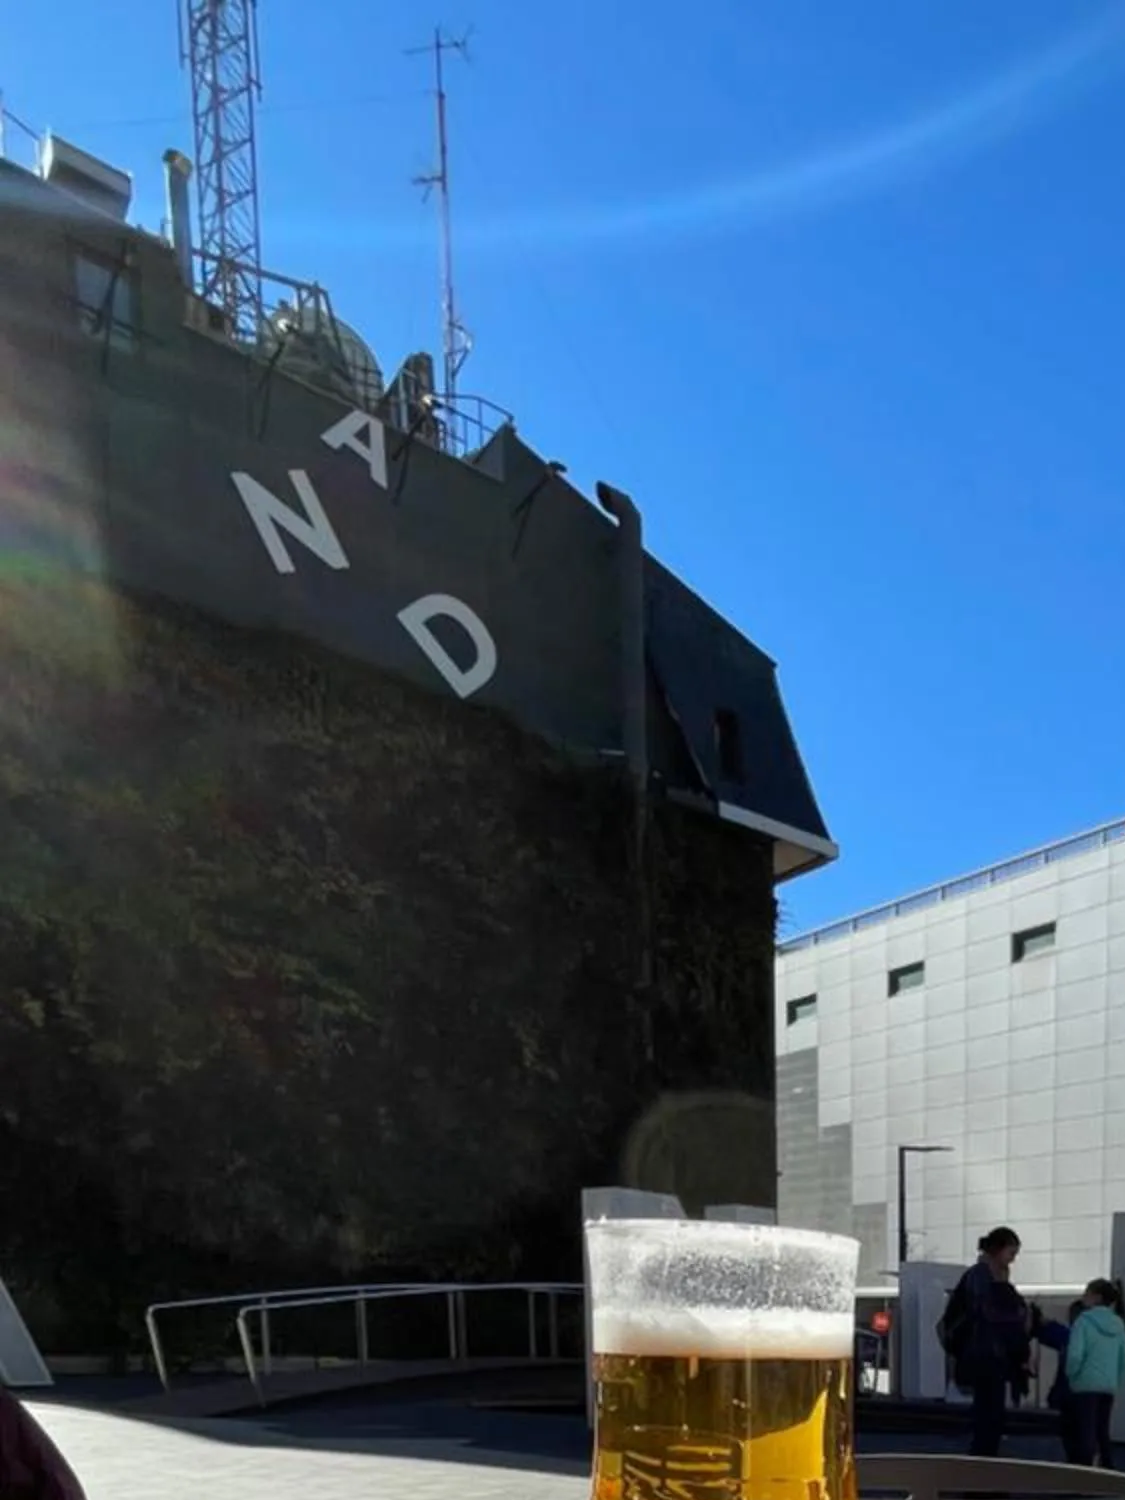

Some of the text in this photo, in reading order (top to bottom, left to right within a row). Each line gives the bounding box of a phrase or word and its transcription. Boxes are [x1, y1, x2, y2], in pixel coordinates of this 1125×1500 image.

[320, 409, 388, 490] A
[230, 469, 350, 574] N
[397, 593, 498, 699] D
